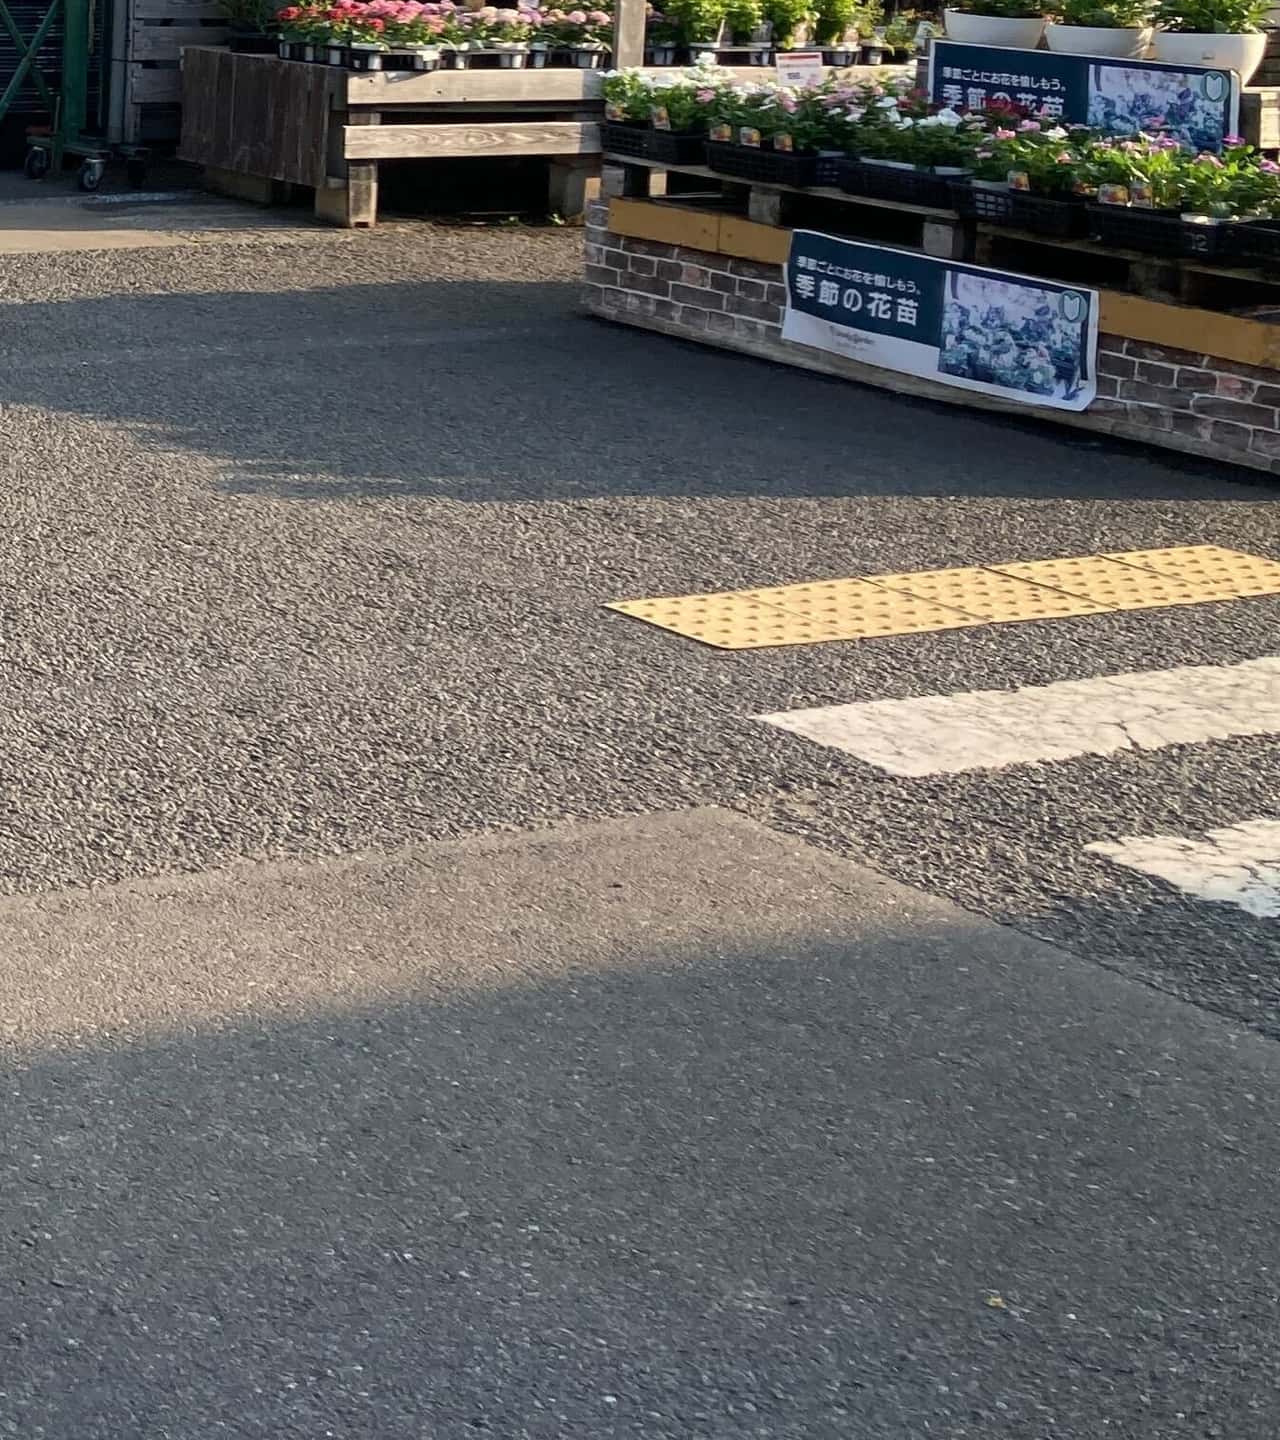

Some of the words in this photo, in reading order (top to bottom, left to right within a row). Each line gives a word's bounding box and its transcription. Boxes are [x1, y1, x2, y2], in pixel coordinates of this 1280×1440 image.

[794, 274, 919, 327] 季節の花苗
